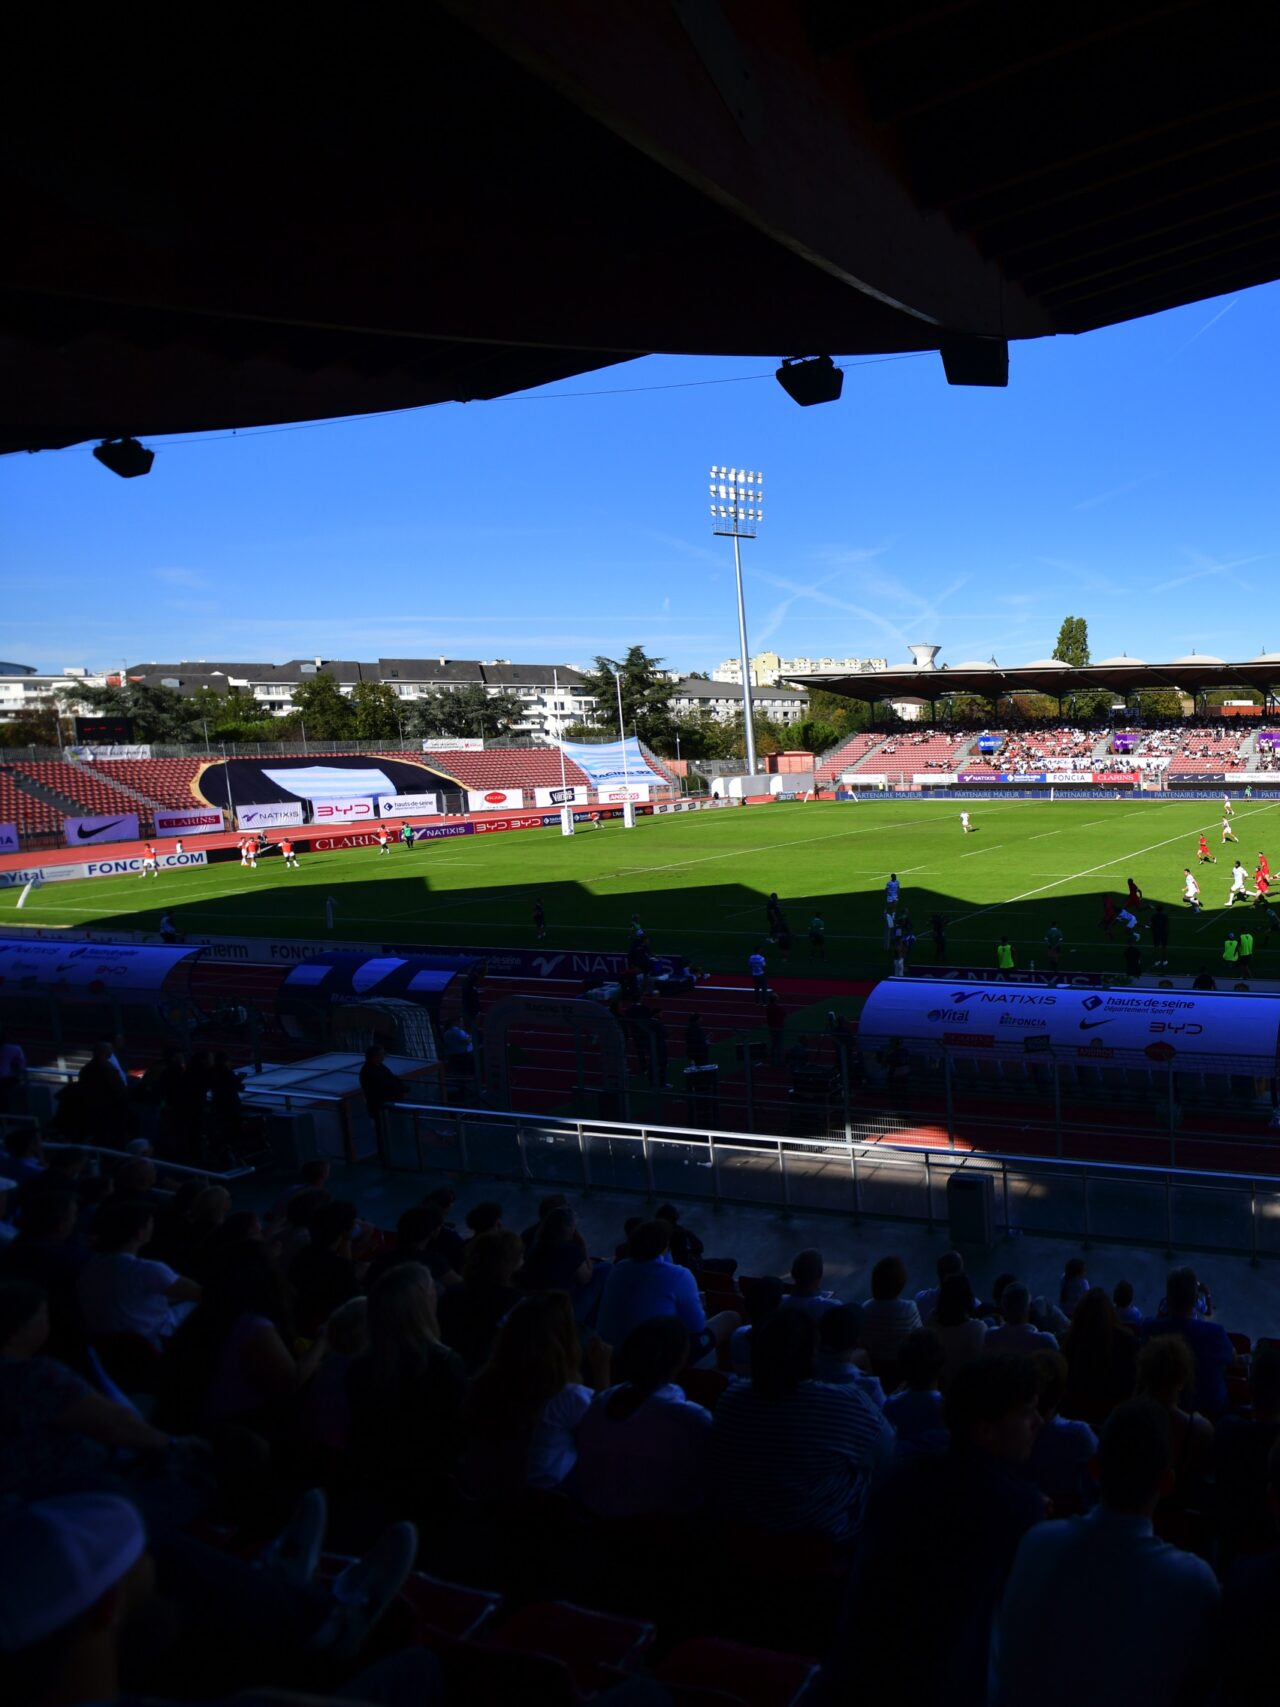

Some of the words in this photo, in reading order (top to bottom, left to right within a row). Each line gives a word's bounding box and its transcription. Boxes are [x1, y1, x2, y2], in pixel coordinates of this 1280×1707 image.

[259, 810, 299, 820] NATIXIS
[317, 804, 371, 816] BYD
[163, 815, 216, 828] CLARINS
[476, 821, 507, 832] BYD
[511, 818, 541, 828] BYD
[426, 826, 465, 837] NATIXIS
[6, 869, 45, 882] Vital
[571, 954, 674, 975] NATIS
[981, 993, 1057, 1005] NATIXIS
[1107, 997, 1195, 1009] hauts-de-seine
[942, 1009, 969, 1021] Vital
[1104, 1005, 1149, 1014] Département
[1151, 1007, 1175, 1015] Sportif
[1012, 1017, 1047, 1026] FONCIA
[1149, 1022, 1203, 1035] BYD
